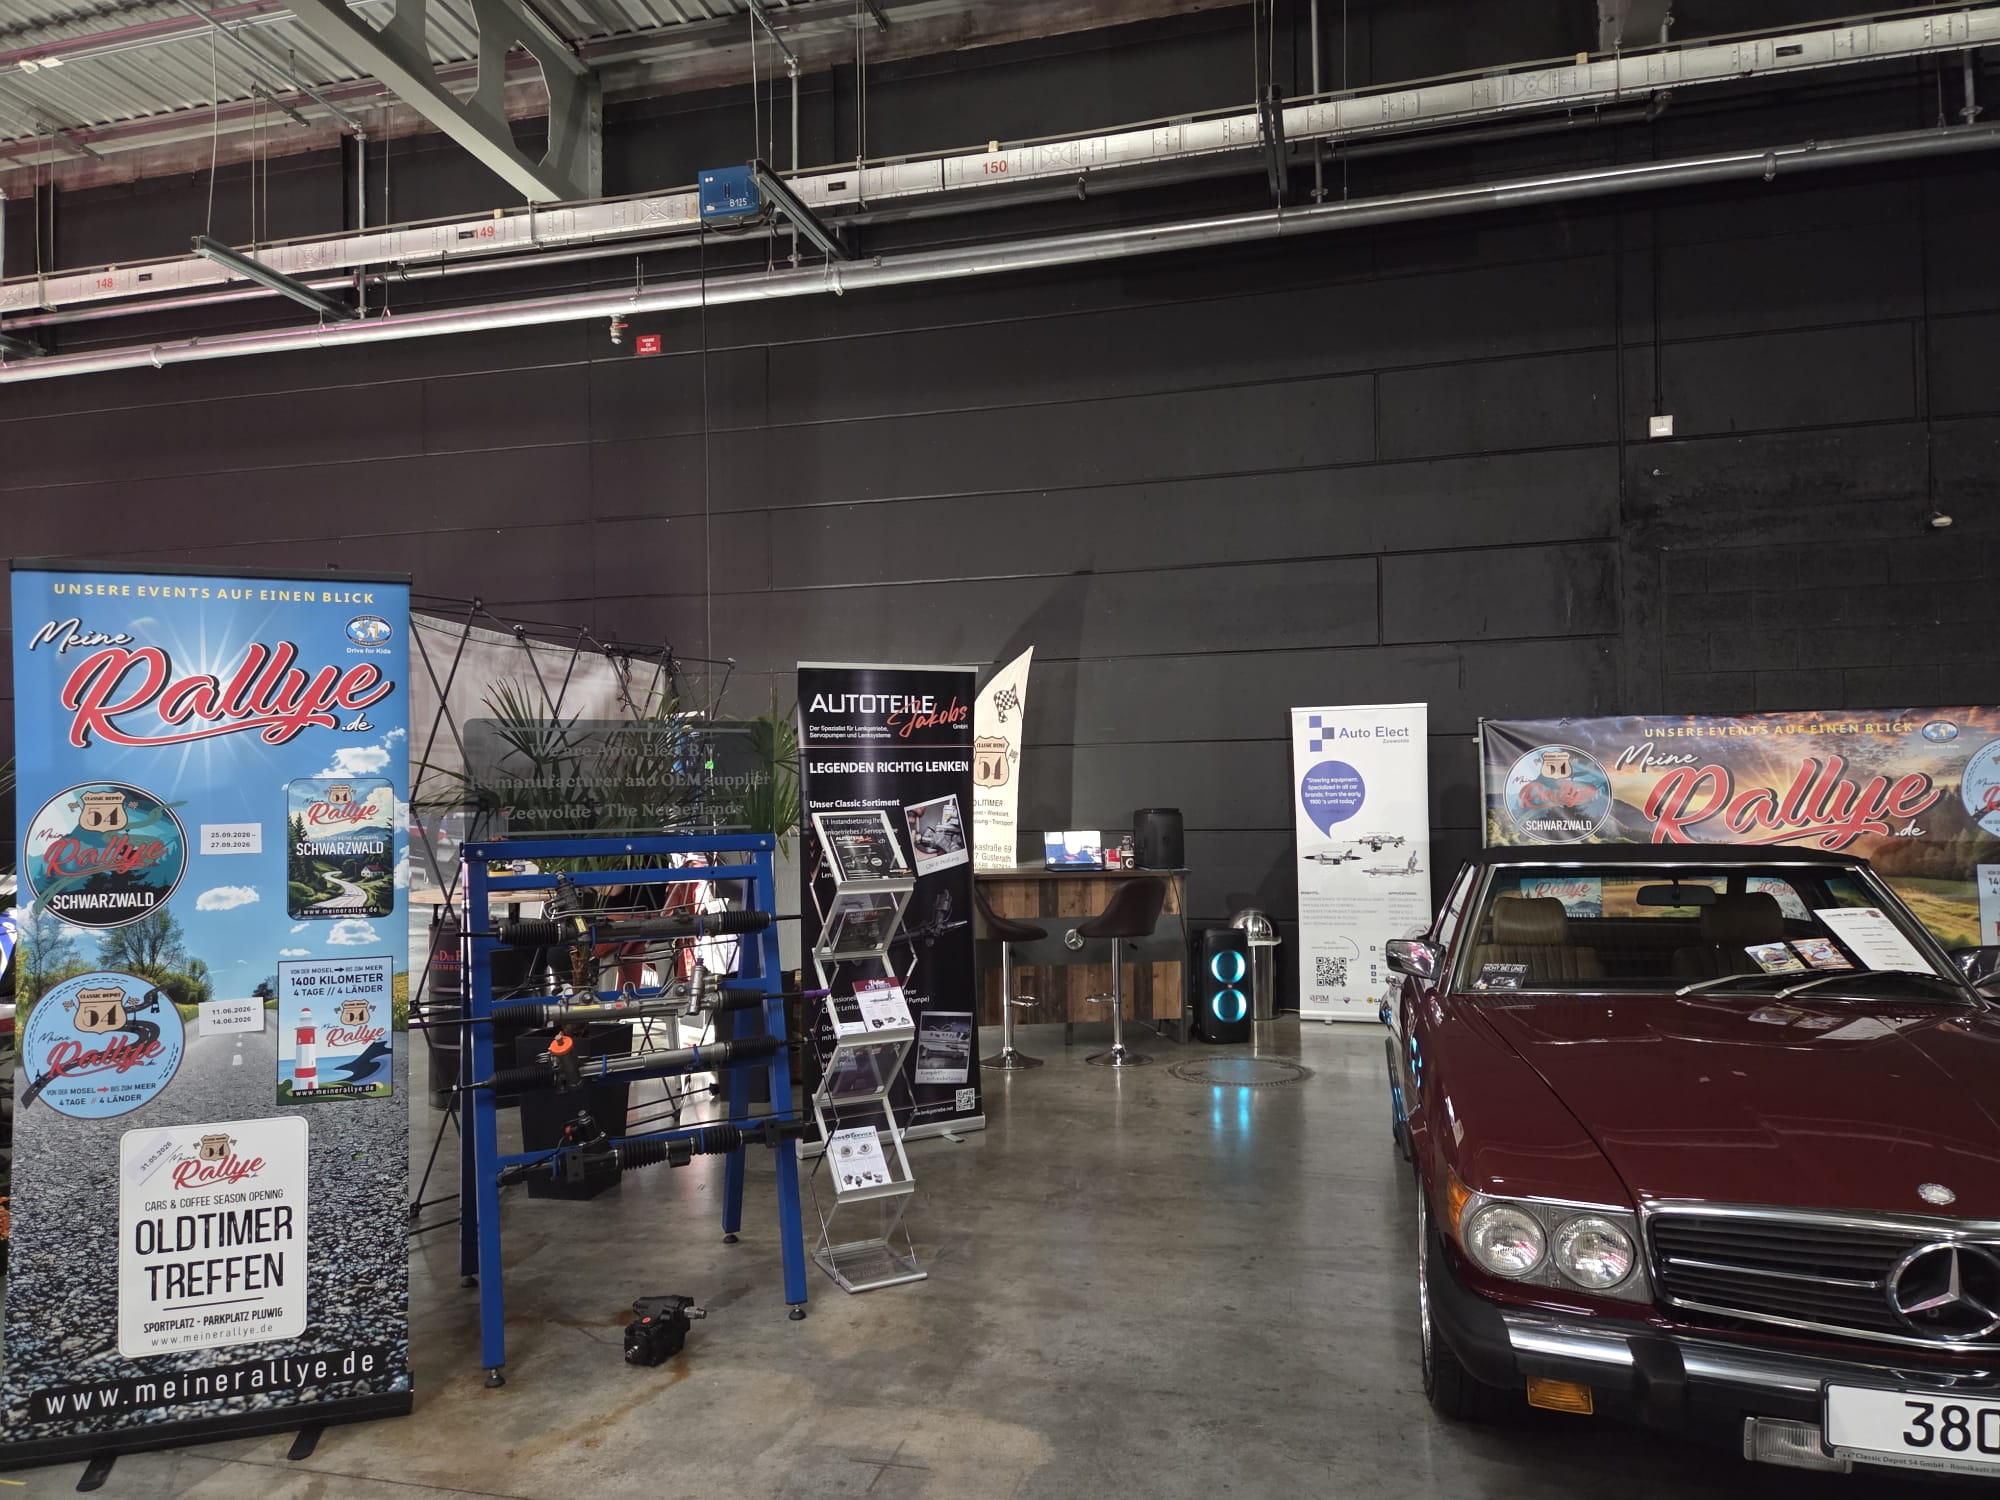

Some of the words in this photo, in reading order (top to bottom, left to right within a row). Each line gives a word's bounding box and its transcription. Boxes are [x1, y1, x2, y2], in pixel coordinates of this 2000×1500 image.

[983, 160, 1007, 174] 150
[730, 198, 747, 207] B125
[474, 226, 494, 239] 149
[96, 278, 112, 288] 148
[54, 583, 130, 597] UNSERE
[137, 585, 211, 599] EVENTS
[217, 588, 253, 600] AUF
[260, 589, 315, 602] EINEN
[322, 591, 374, 604] BLICK
[29, 617, 135, 653] Meine
[61, 640, 395, 748] Rallye
[341, 713, 373, 732] .de
[809, 694, 935, 713] AUTOTEILE
[886, 696, 968, 738] Jakobs
[1339, 728, 1371, 738] Auto
[1375, 726, 1409, 738] Elect
[1644, 725, 1704, 738] UNSERE
[1709, 725, 1768, 736] EVENTS
[1774, 724, 1805, 735] AUF
[1810, 722, 1859, 735] EINEN
[1865, 721, 1913, 733] BLICK
[1615, 742, 1698, 773] Meine
[809, 761, 874, 774] LEGENDEN
[877, 761, 923, 773] RICHTIG
[926, 761, 969, 773] LENKEN
[977, 756, 1003, 780] 54
[625, 773, 657, 787] and
[661, 773, 701, 787] OEM
[704, 771, 771, 790] supplier
[506, 804, 592, 820] Zeewolde
[604, 803, 638, 817] The
[642, 802, 744, 817] Netherlands
[809, 800, 833, 809] Unser
[834, 799, 861, 808] Classic
[862, 799, 900, 807] Sortiment
[1644, 755, 1945, 850] Rallye
[1895, 819, 1926, 837] .de
[86, 806, 120, 826] 54
[308, 800, 379, 825] Rallye
[830, 817, 872, 826] Instandsetzung
[1526, 820, 1592, 831] SCHWARZWALD
[43, 835, 168, 877] Rallye
[296, 841, 384, 856] SCHWARZWALD
[52, 892, 154, 910] SCHWARZWALD
[303, 906, 378, 915] www.meinerallye.de
[291, 976, 316, 986] 1400
[320, 973, 383, 984] KILOMETER
[301, 988, 325, 996] TAGE
[346, 984, 383, 994] LÄNDER
[82, 1004, 119, 1027] 54
[212, 1017, 252, 1025] 14.06.2026
[326, 1025, 386, 1047] Rallye
[47, 1035, 166, 1079] Rallye
[107, 1094, 142, 1103] LÄNDER
[295, 1085, 375, 1097] www.meinerallye.de
[140, 1141, 173, 1171] 31.05.2026
[172, 1154, 266, 1190] Rallye
[145, 1201, 168, 1212] CARS
[180, 1196, 211, 1208] COFFEE
[213, 1192, 247, 1204] SEASON
[248, 1188, 284, 1202] OPENING
[135, 1205, 293, 1256] OLDTIMER
[144, 1252, 284, 1301] TREFFEN
[144, 1318, 194, 1333] SPORTPLATZ
[203, 1311, 249, 1326] PARKPLATZ
[252, 1307, 283, 1320] PLUWIG
[151, 1324, 273, 1347] www.meinerallye.de
[46, 1350, 375, 1415] www.meinerallye.de
[1855, 1453, 1881, 1462] Classic
[1883, 1457, 1907, 1466] Depot
[1920, 1461, 1944, 1469] GmbH
